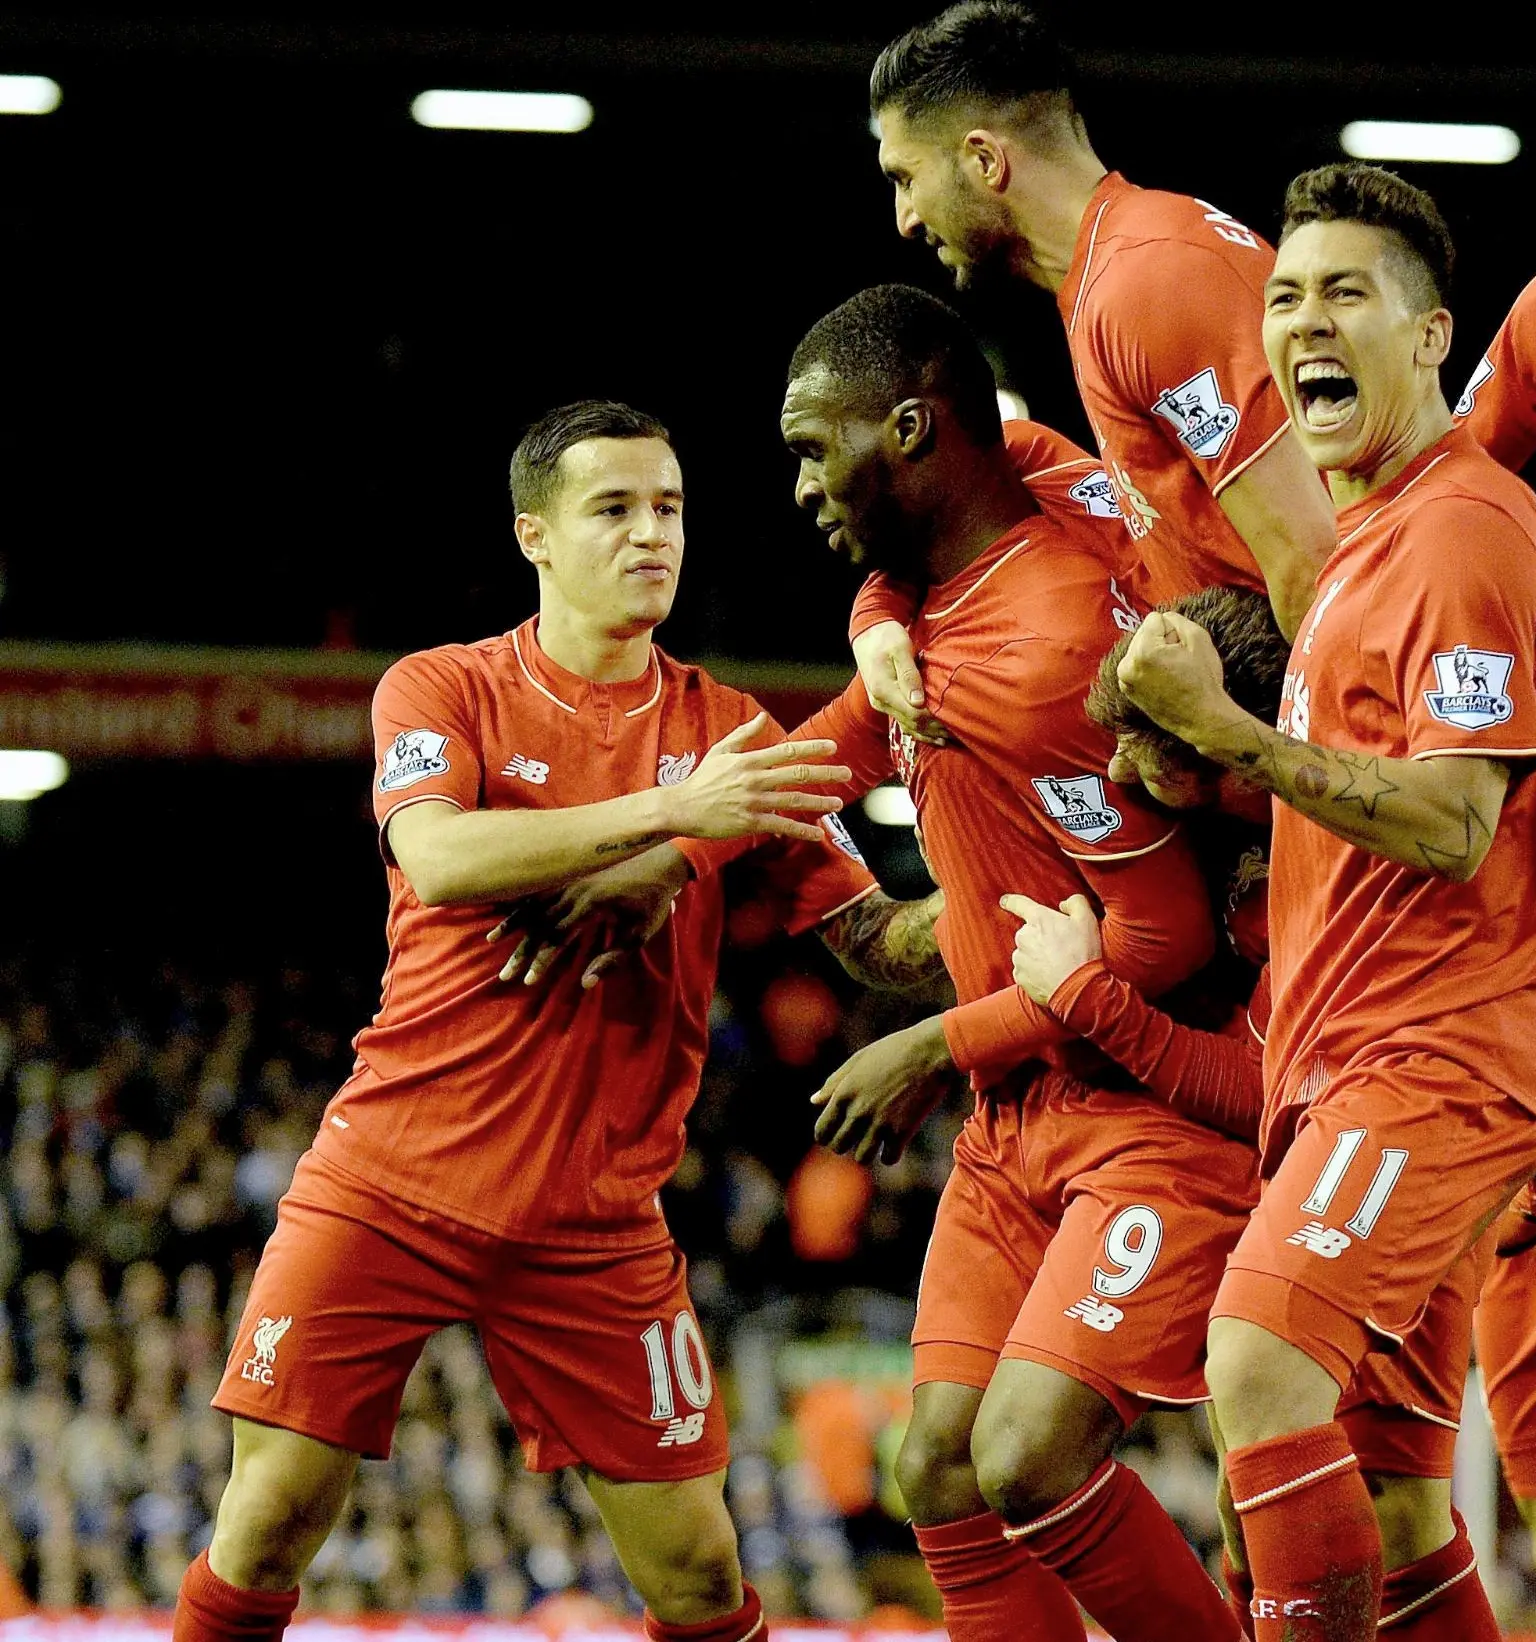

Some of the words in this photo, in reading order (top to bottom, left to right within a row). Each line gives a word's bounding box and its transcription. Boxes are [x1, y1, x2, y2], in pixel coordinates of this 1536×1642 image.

[1442, 695, 1492, 707] BARCLAYS
[1300, 1128, 1410, 1240] 11
[1092, 1204, 1164, 1298] 9
[640, 1310, 713, 1420] 10
